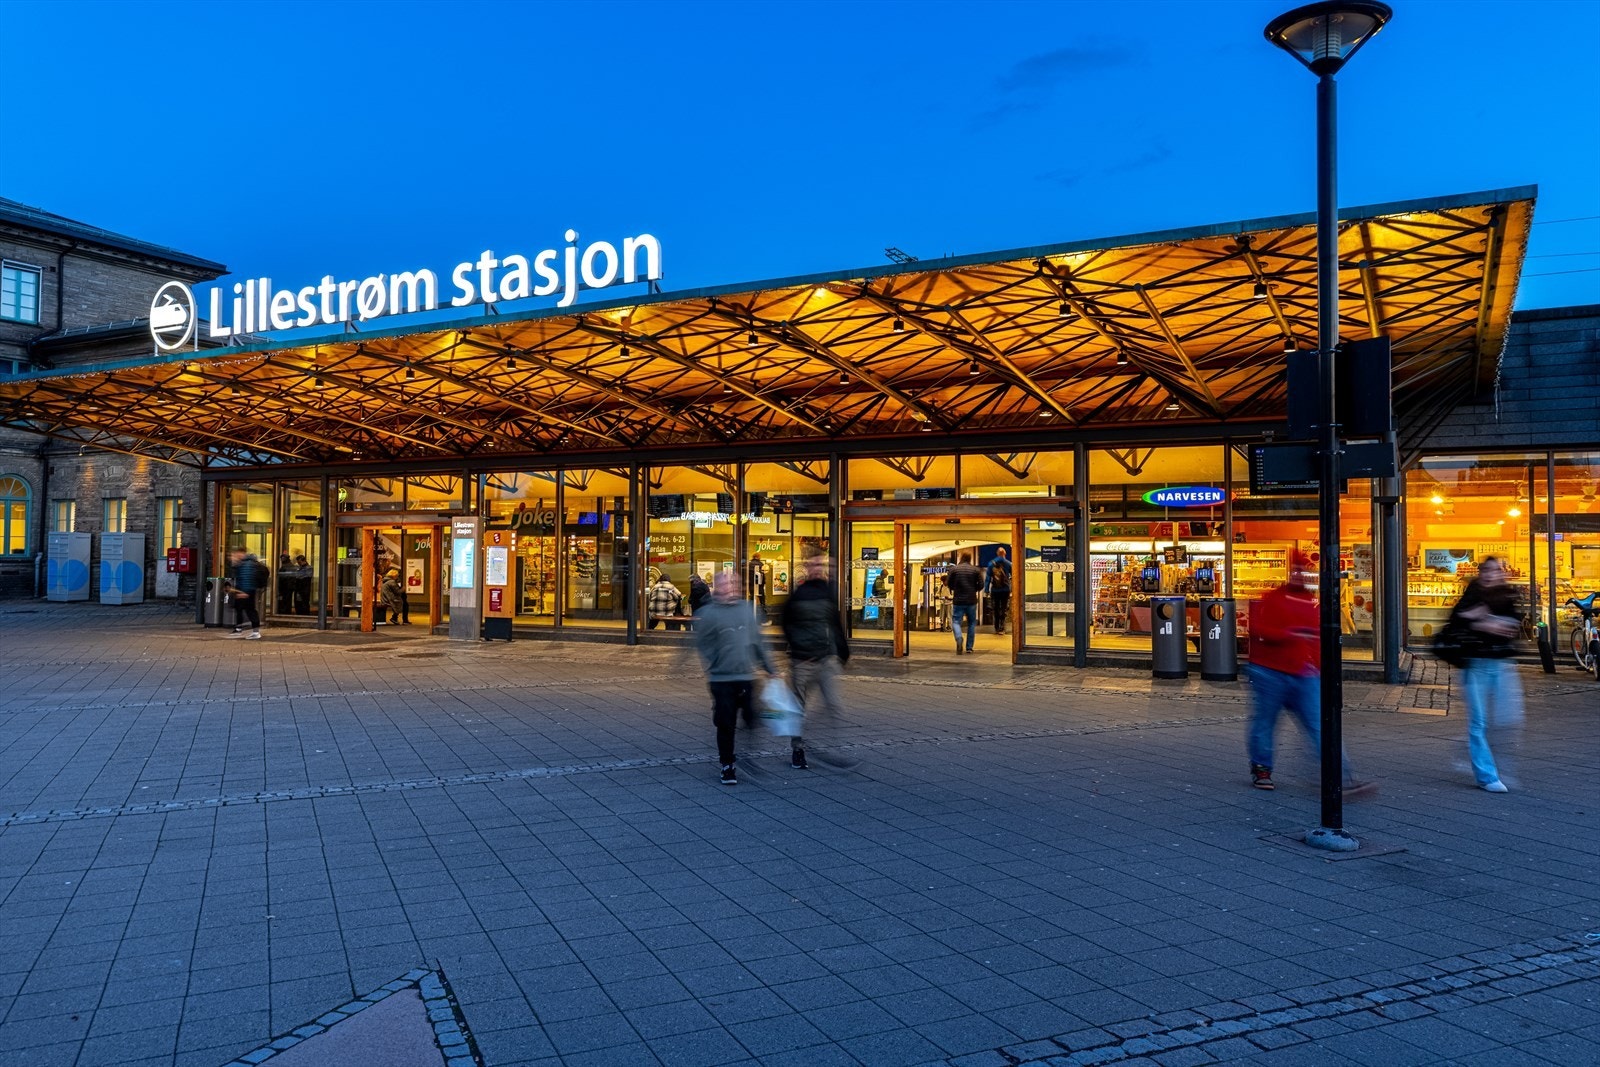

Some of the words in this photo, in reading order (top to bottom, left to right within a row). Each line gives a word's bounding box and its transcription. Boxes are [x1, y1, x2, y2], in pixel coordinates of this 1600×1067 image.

[210, 268, 438, 338] Lillestrøm
[451, 229, 663, 309] stasjon
[1157, 492, 1221, 502] NARVESEN
[512, 501, 557, 530] joke
[673, 535, 686, 543] 6-23
[757, 537, 782, 553] joker
[673, 545, 686, 553] 8-23
